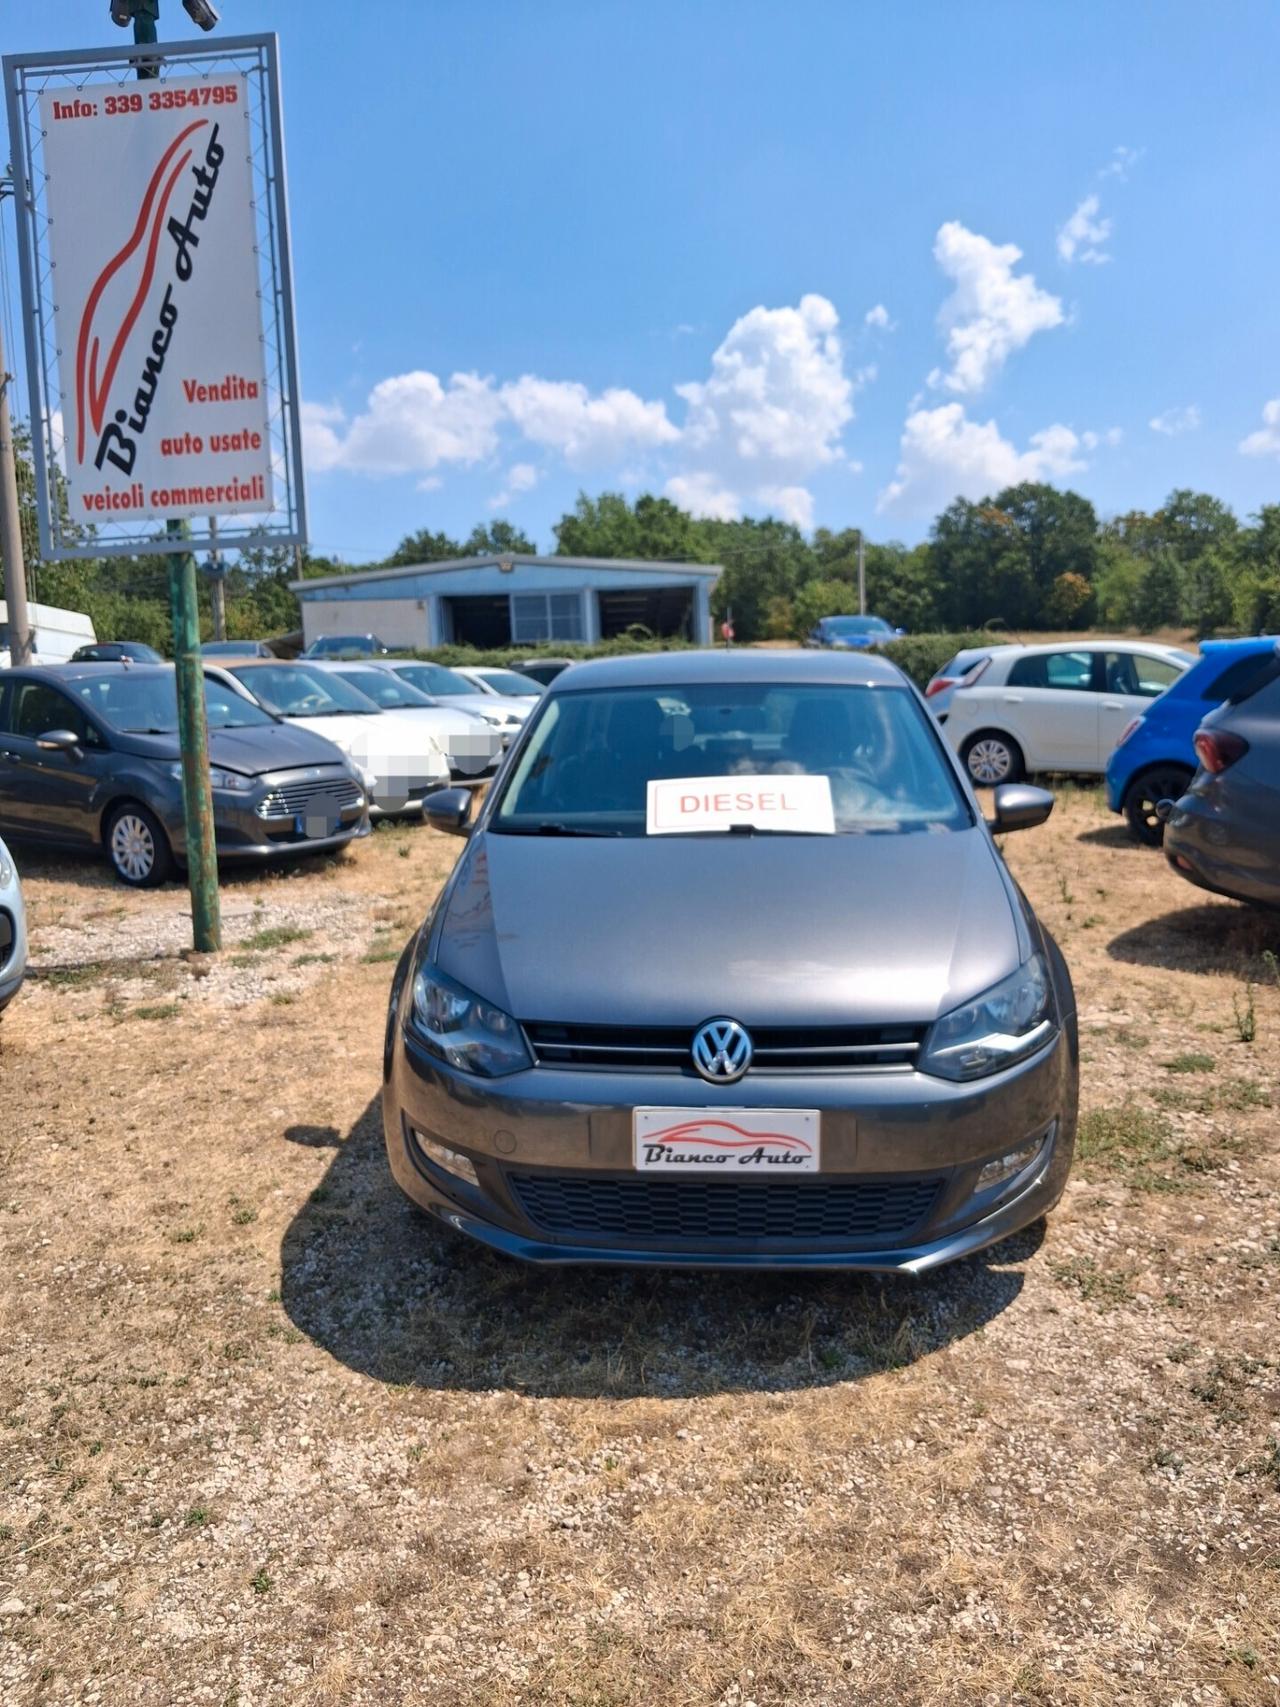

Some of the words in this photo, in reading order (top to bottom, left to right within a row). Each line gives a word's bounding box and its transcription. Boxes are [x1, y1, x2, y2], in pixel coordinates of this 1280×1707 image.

[53, 100, 97, 120] Info:
[104, 94, 143, 115] 339
[149, 85, 238, 111] 3354795
[94, 283, 180, 477] Bianco
[167, 122, 225, 282] Auto
[182, 376, 259, 404] Vendita
[160, 435, 204, 456] auto
[209, 430, 262, 454] usate
[82, 484, 145, 511] veicoli
[150, 476, 265, 508] commerciali
[680, 793, 797, 814] DIESEL
[642, 1143, 736, 1165] Bianco
[738, 1146, 813, 1166] Auto
